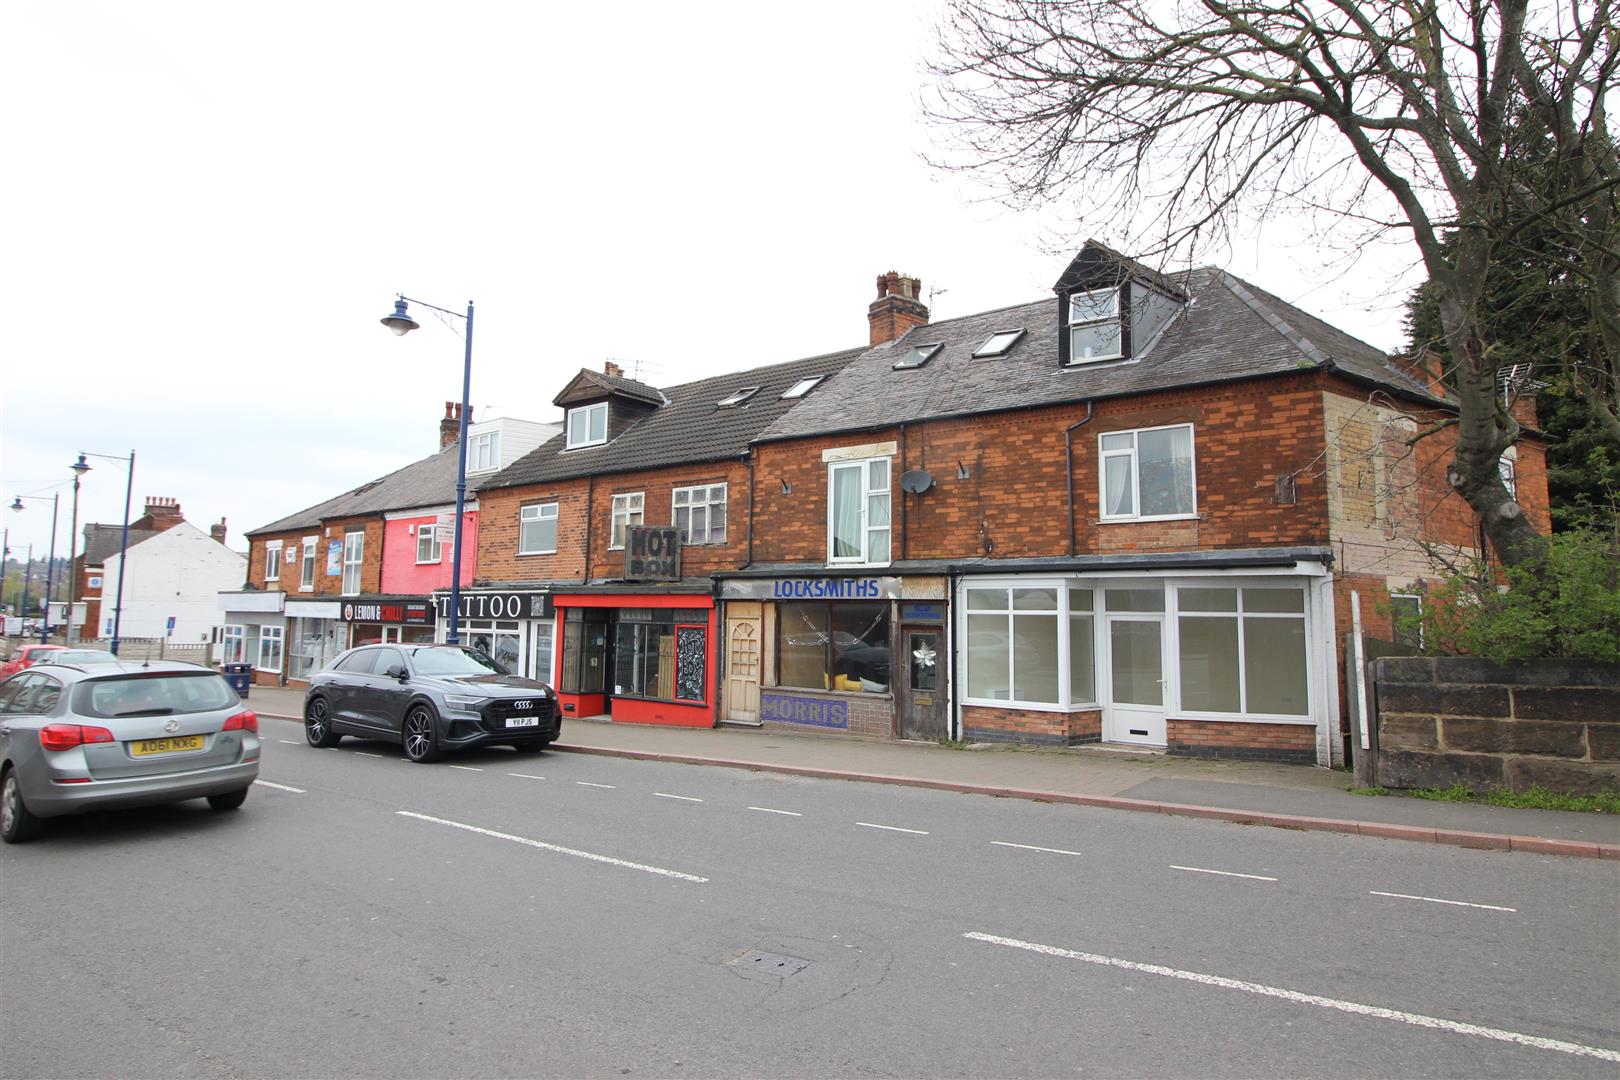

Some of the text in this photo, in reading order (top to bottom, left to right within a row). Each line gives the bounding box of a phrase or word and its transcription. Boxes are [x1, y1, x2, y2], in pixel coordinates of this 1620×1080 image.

[631, 528, 677, 556] HOT
[630, 560, 676, 576] BOX
[774, 579, 879, 598] LOCKSMITHS
[354, 605, 375, 620] LEMON
[376, 605, 381, 620] &
[440, 595, 521, 618] TTTOO
[761, 700, 844, 725] MORRIS
[173, 738, 197, 749] NXG
